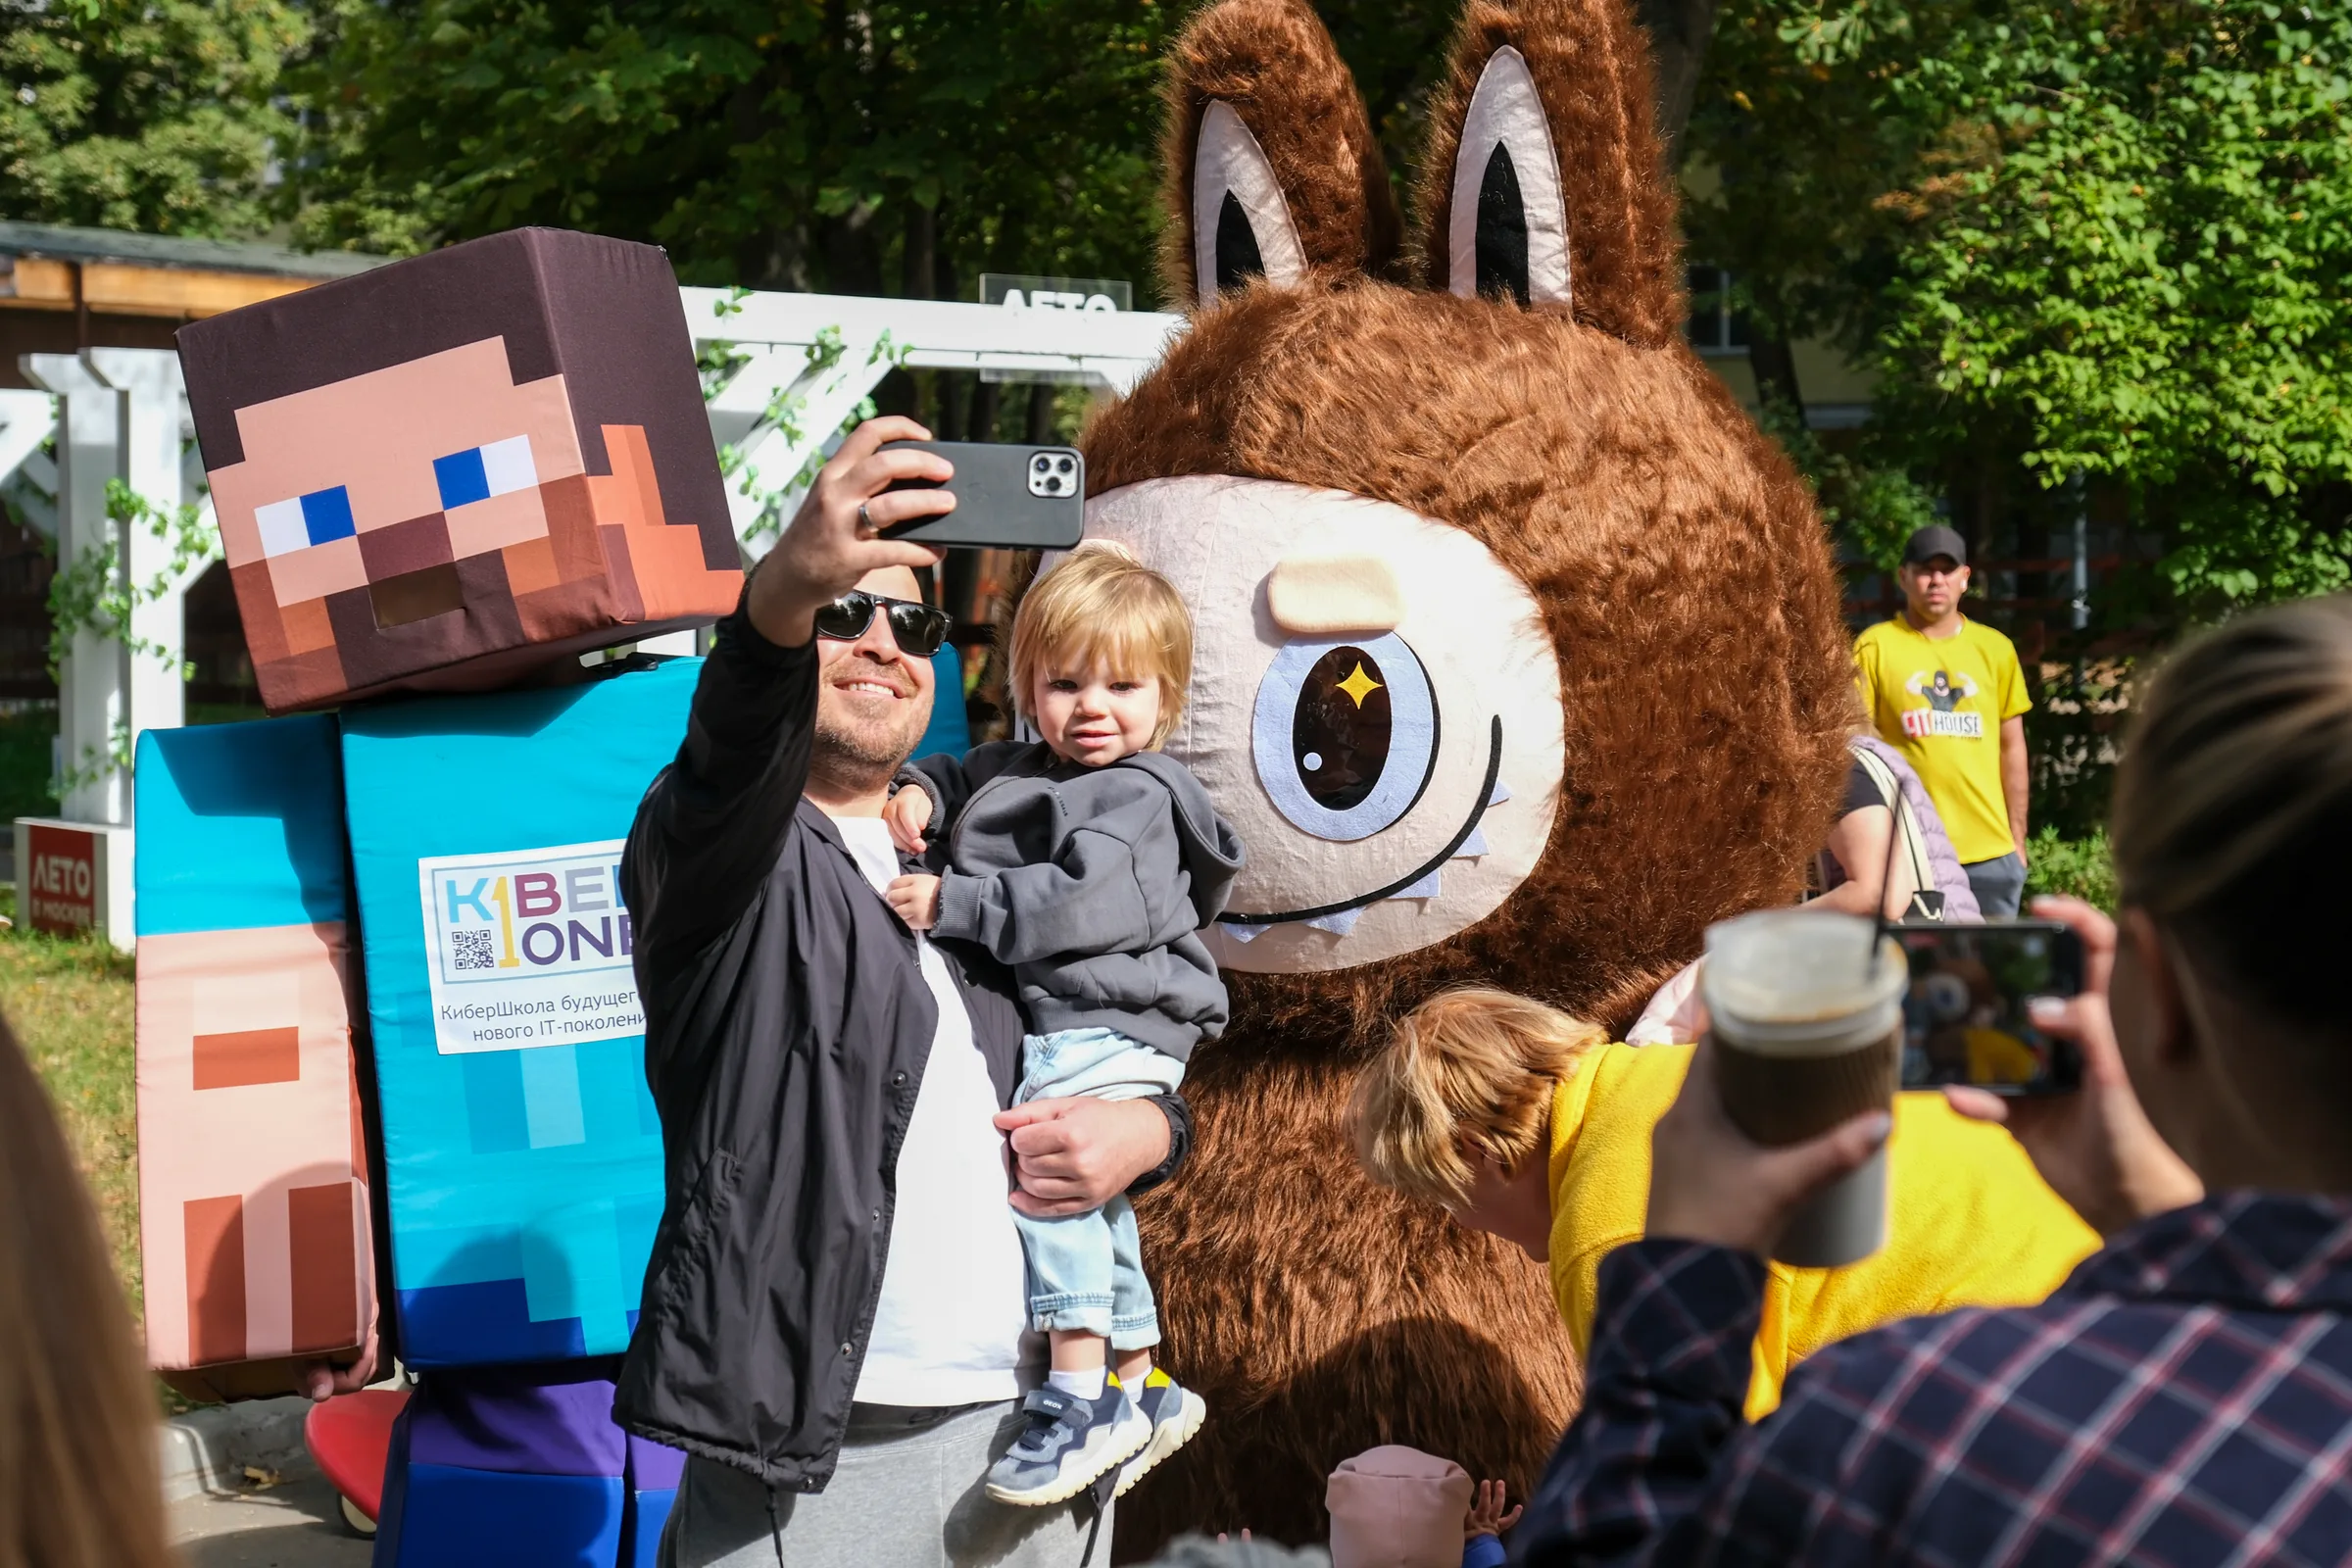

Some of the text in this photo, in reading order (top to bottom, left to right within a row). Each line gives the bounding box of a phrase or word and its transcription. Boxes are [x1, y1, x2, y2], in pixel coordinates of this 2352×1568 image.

[32, 854, 91, 899] ЛЕТО
[441, 990, 640, 1021] КиберШкола будущег
[473, 1013, 647, 1041] нового IT-поколени
